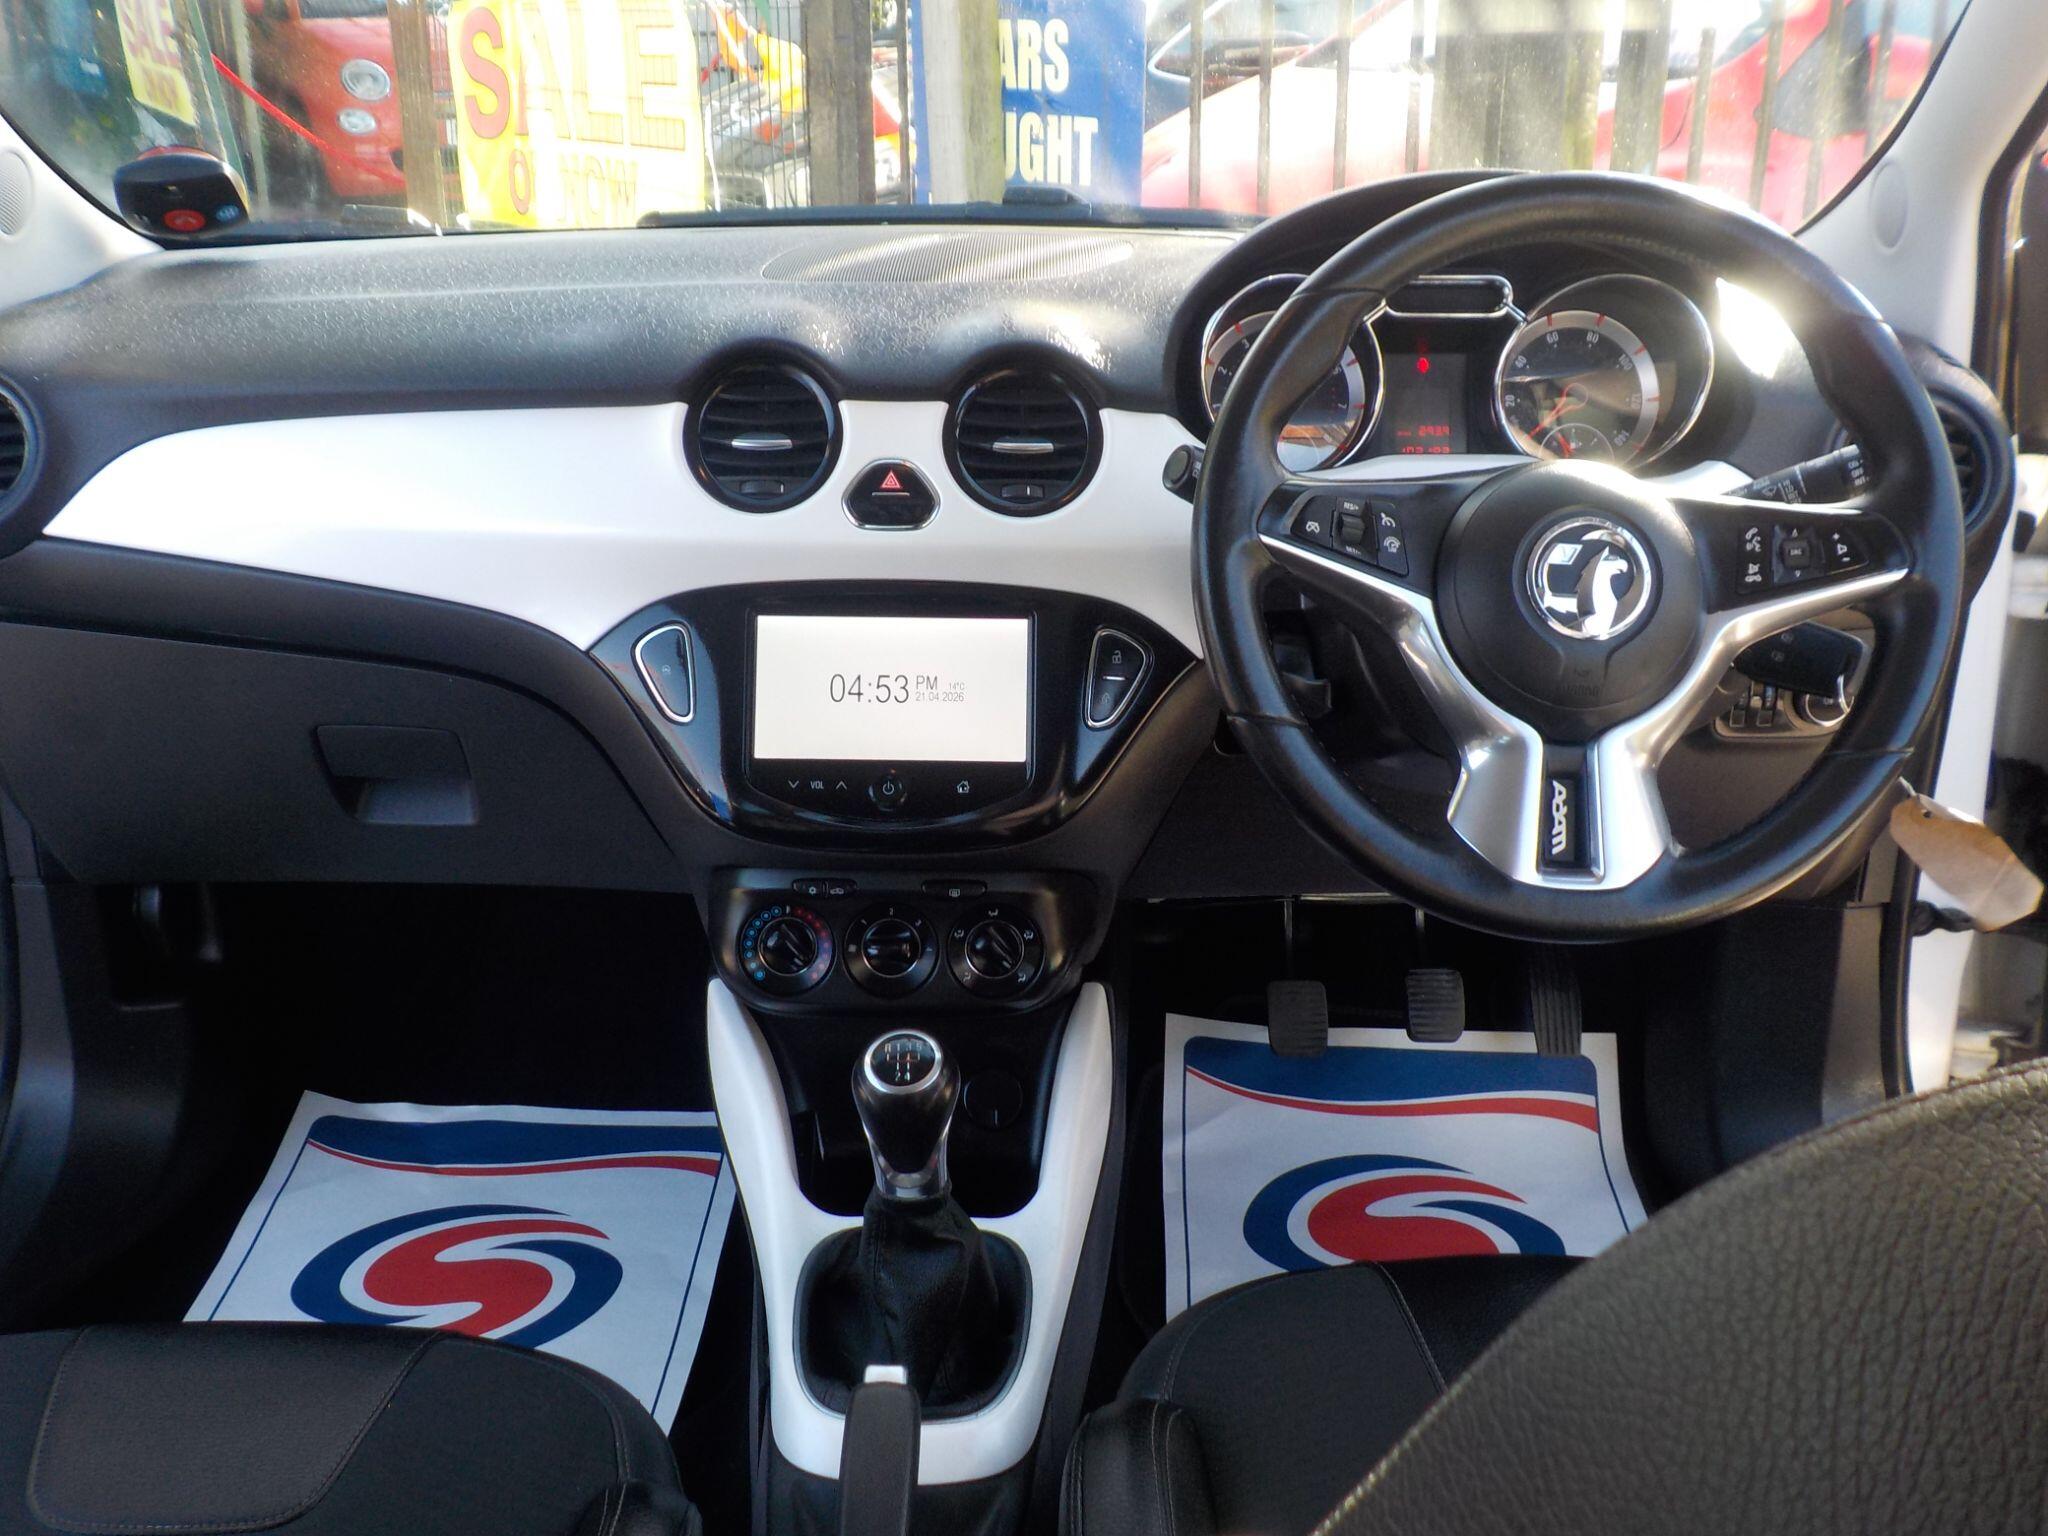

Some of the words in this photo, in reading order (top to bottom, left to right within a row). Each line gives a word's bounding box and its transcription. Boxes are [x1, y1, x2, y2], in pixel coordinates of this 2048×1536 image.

[999, 18, 1069, 93] ARS
[460, 0, 686, 151] SALE
[1003, 111, 1099, 187] UGHT
[1546, 331, 1559, 344] 60
[1586, 331, 1599, 344] 80
[1515, 354, 1527, 369] 40
[1618, 353, 1634, 371] 100
[1505, 394, 1515, 408] 20
[829, 673, 909, 704] 04:53
[916, 675, 938, 690] PM
[810, 780, 824, 790] VOL
